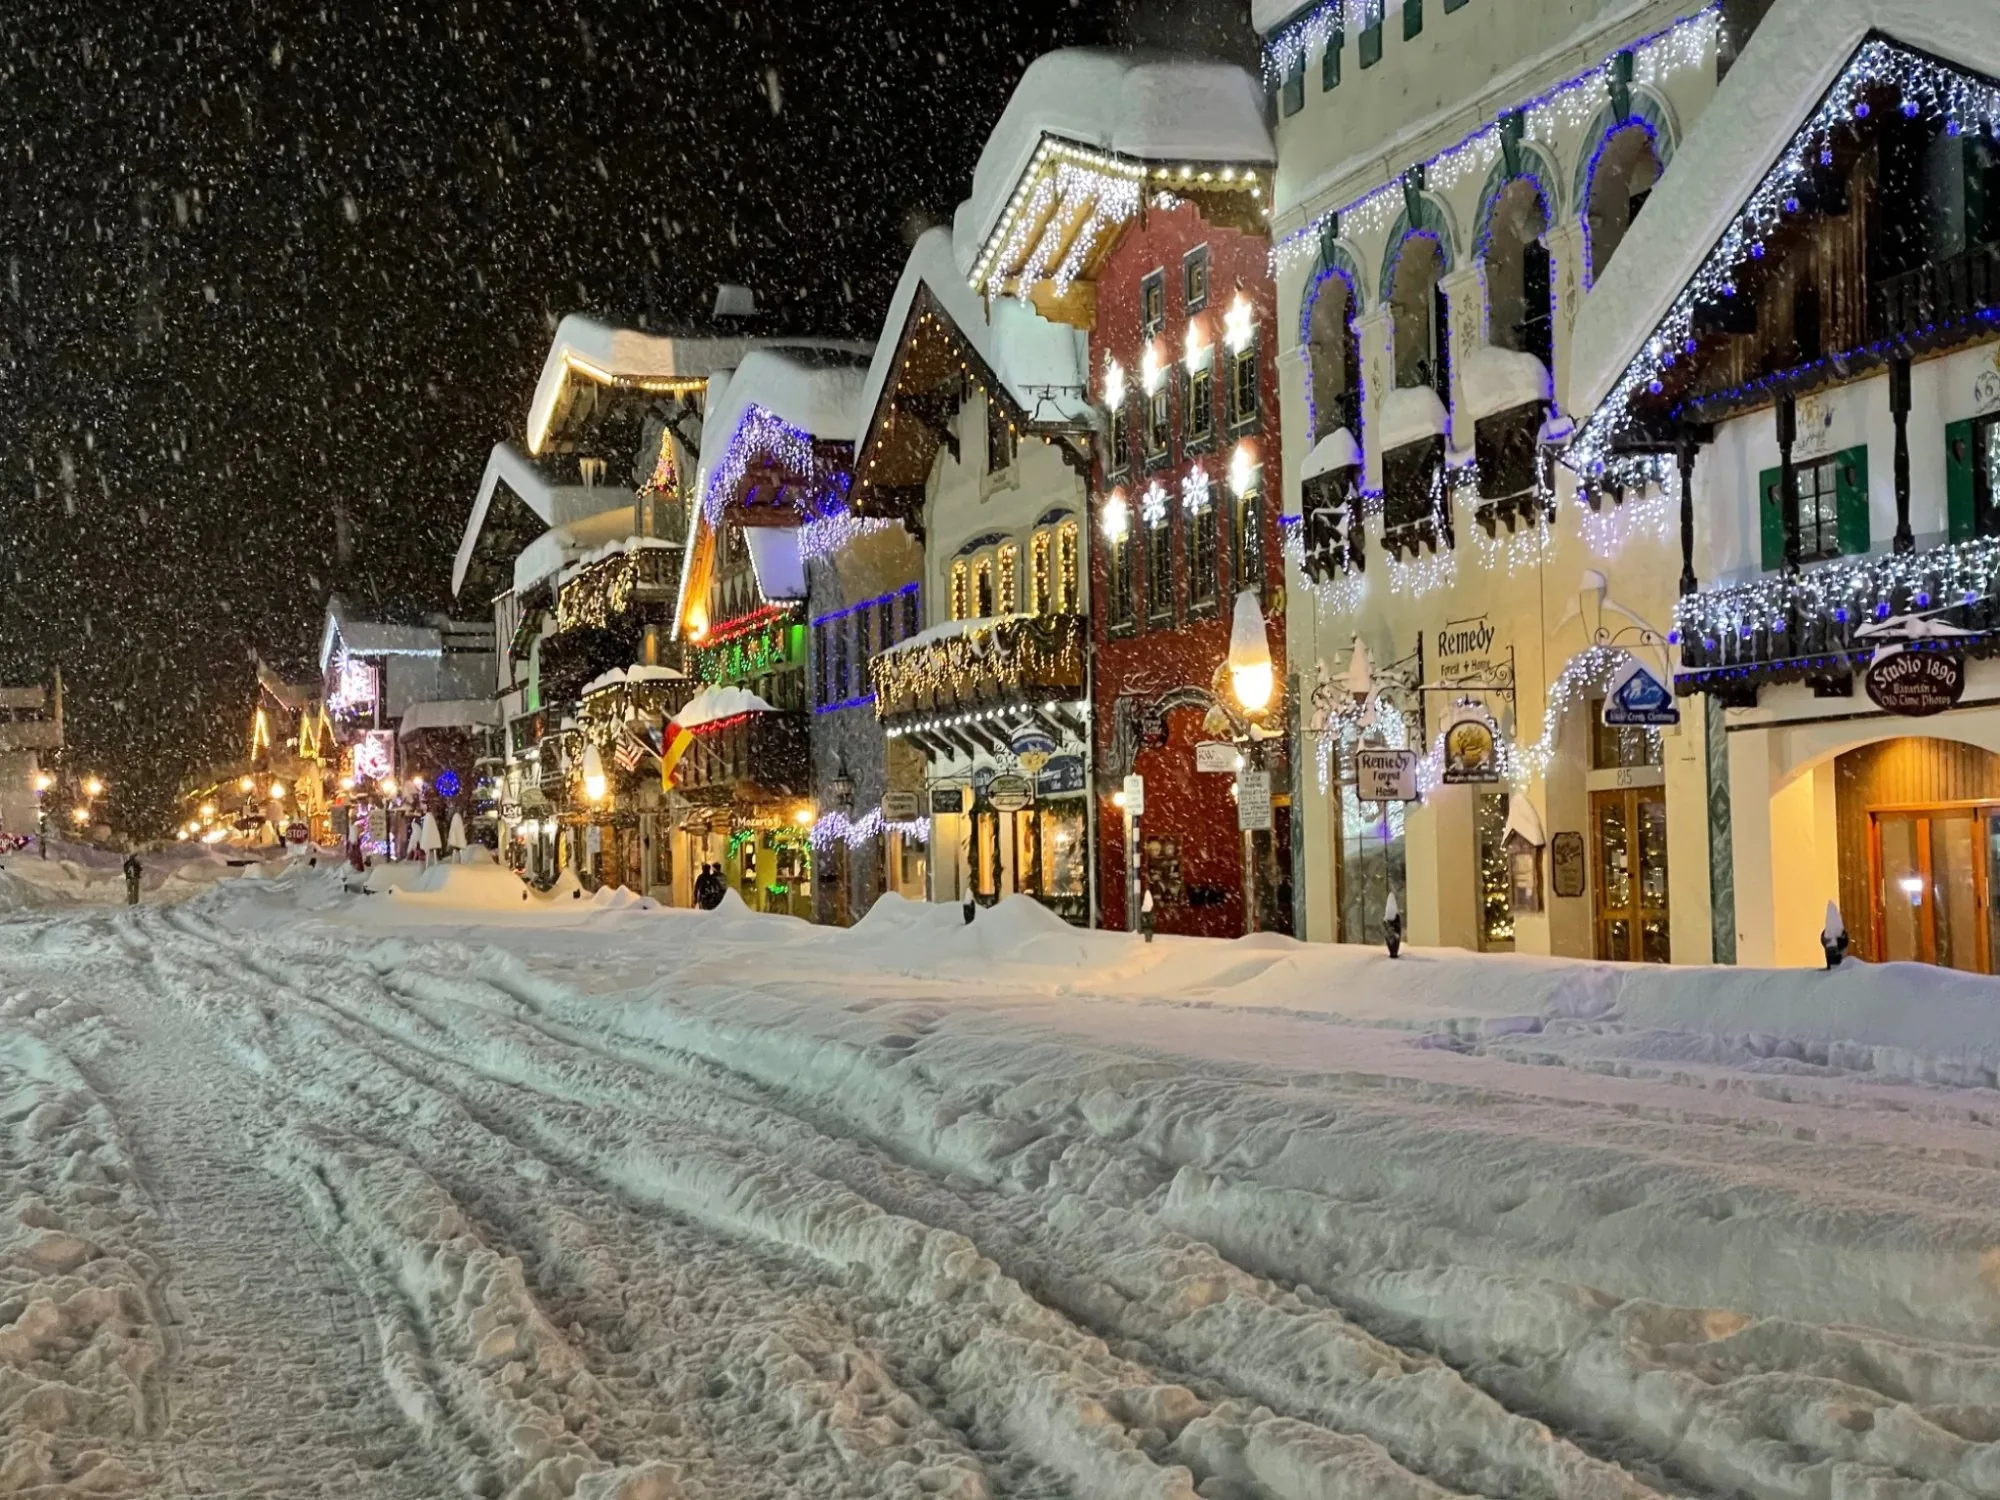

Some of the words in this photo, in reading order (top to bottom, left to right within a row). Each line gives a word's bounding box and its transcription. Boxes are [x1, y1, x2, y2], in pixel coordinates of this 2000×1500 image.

[1438, 620, 1495, 658] Remedy
[1873, 655, 1922, 689] Studio
[1926, 658, 1957, 686] 1890
[1881, 695, 1898, 706] Old
[1362, 752, 1410, 772] Remedy
[1616, 769, 1632, 786] 815
[287, 828, 307, 839] STOP
